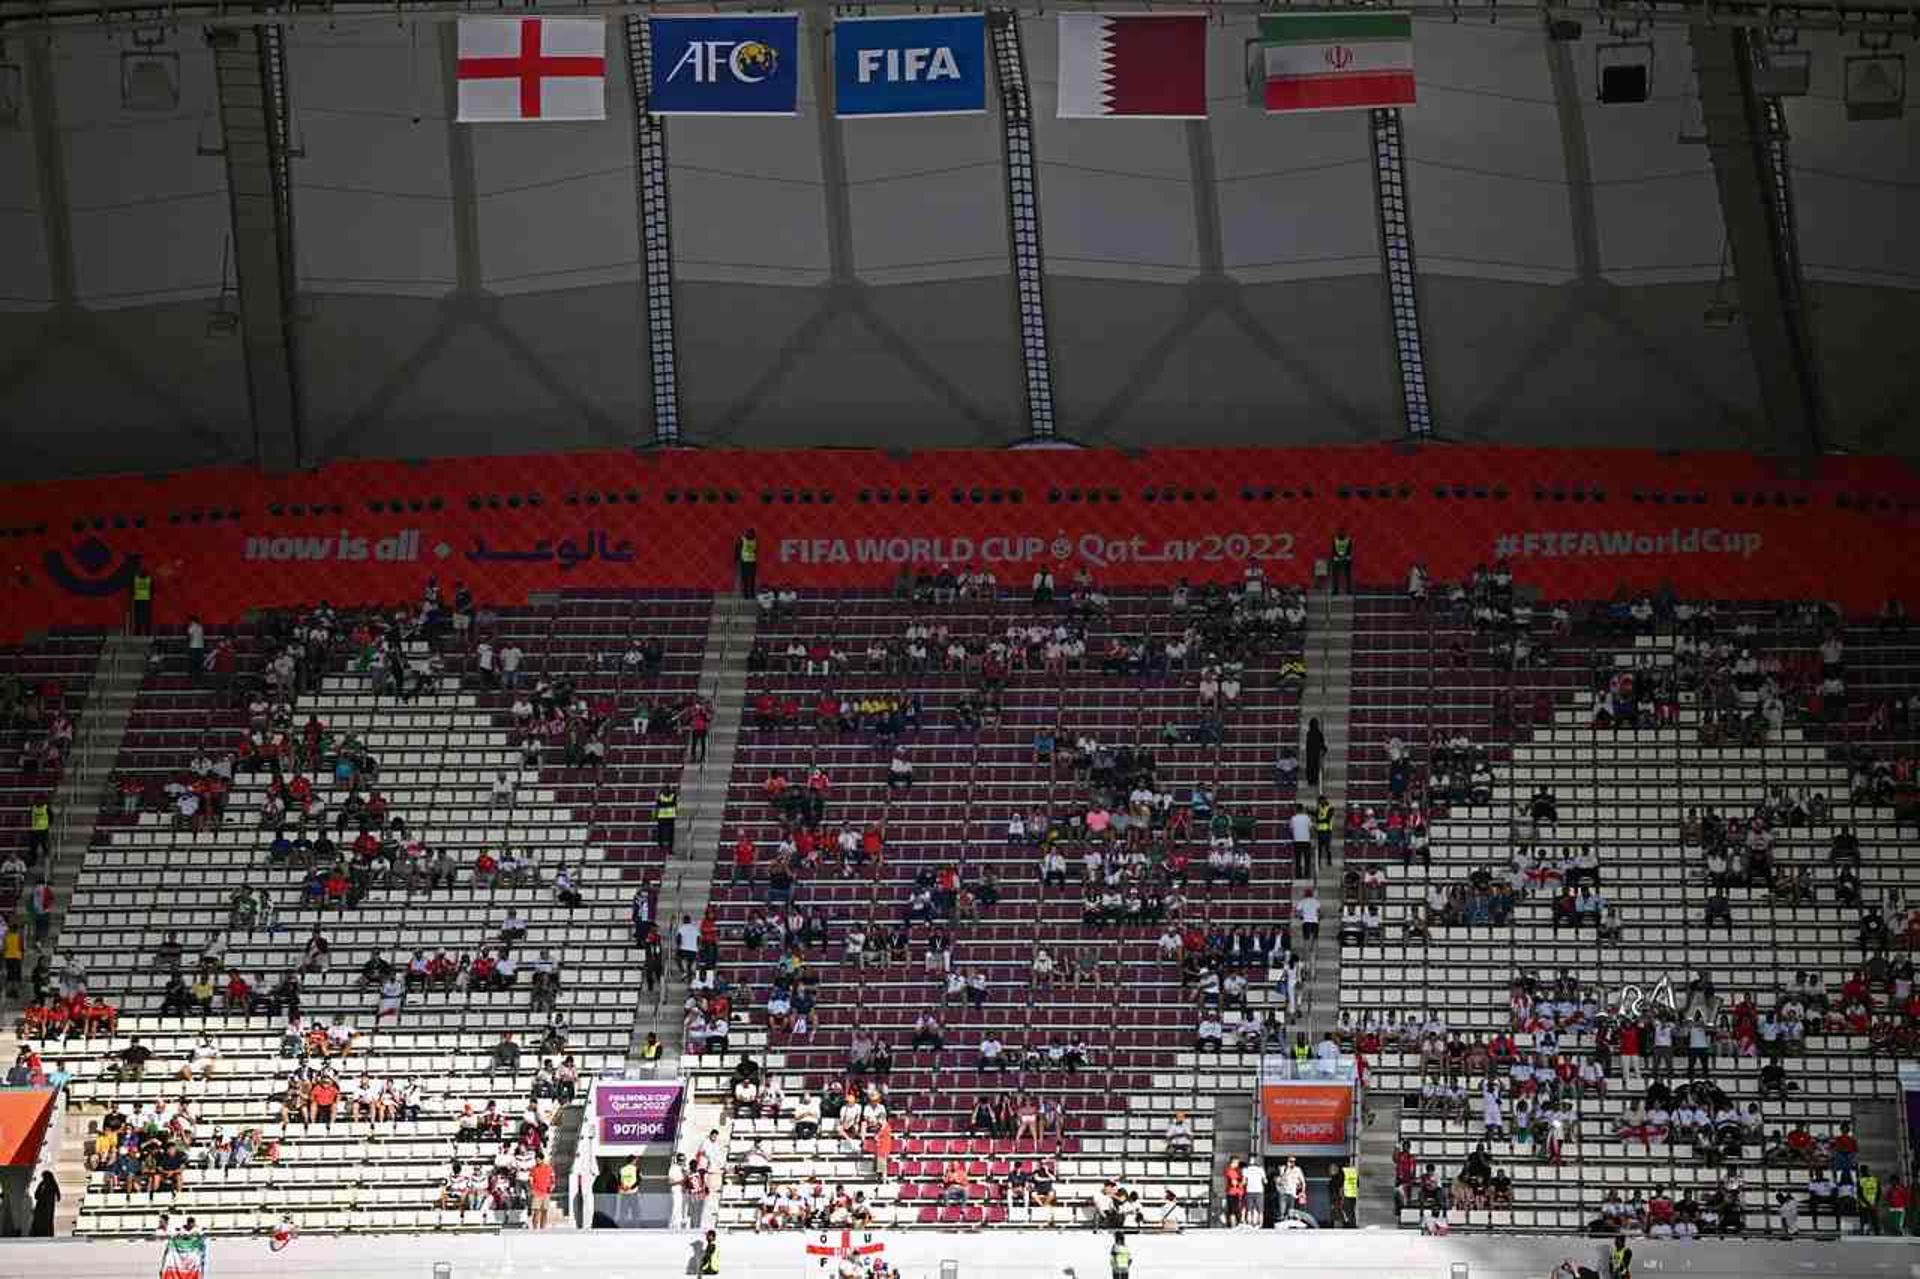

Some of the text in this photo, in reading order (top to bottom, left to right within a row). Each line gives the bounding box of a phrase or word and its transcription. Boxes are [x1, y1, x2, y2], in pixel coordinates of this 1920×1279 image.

[666, 39, 777, 83] AFC
[857, 46, 962, 83] FIFA
[245, 529, 421, 562] now is all
[780, 538, 851, 564] FIFA
[855, 537, 974, 564] WORLD
[981, 537, 1046, 563] CUP
[1495, 529, 1763, 558] #FIFAWorldCup
